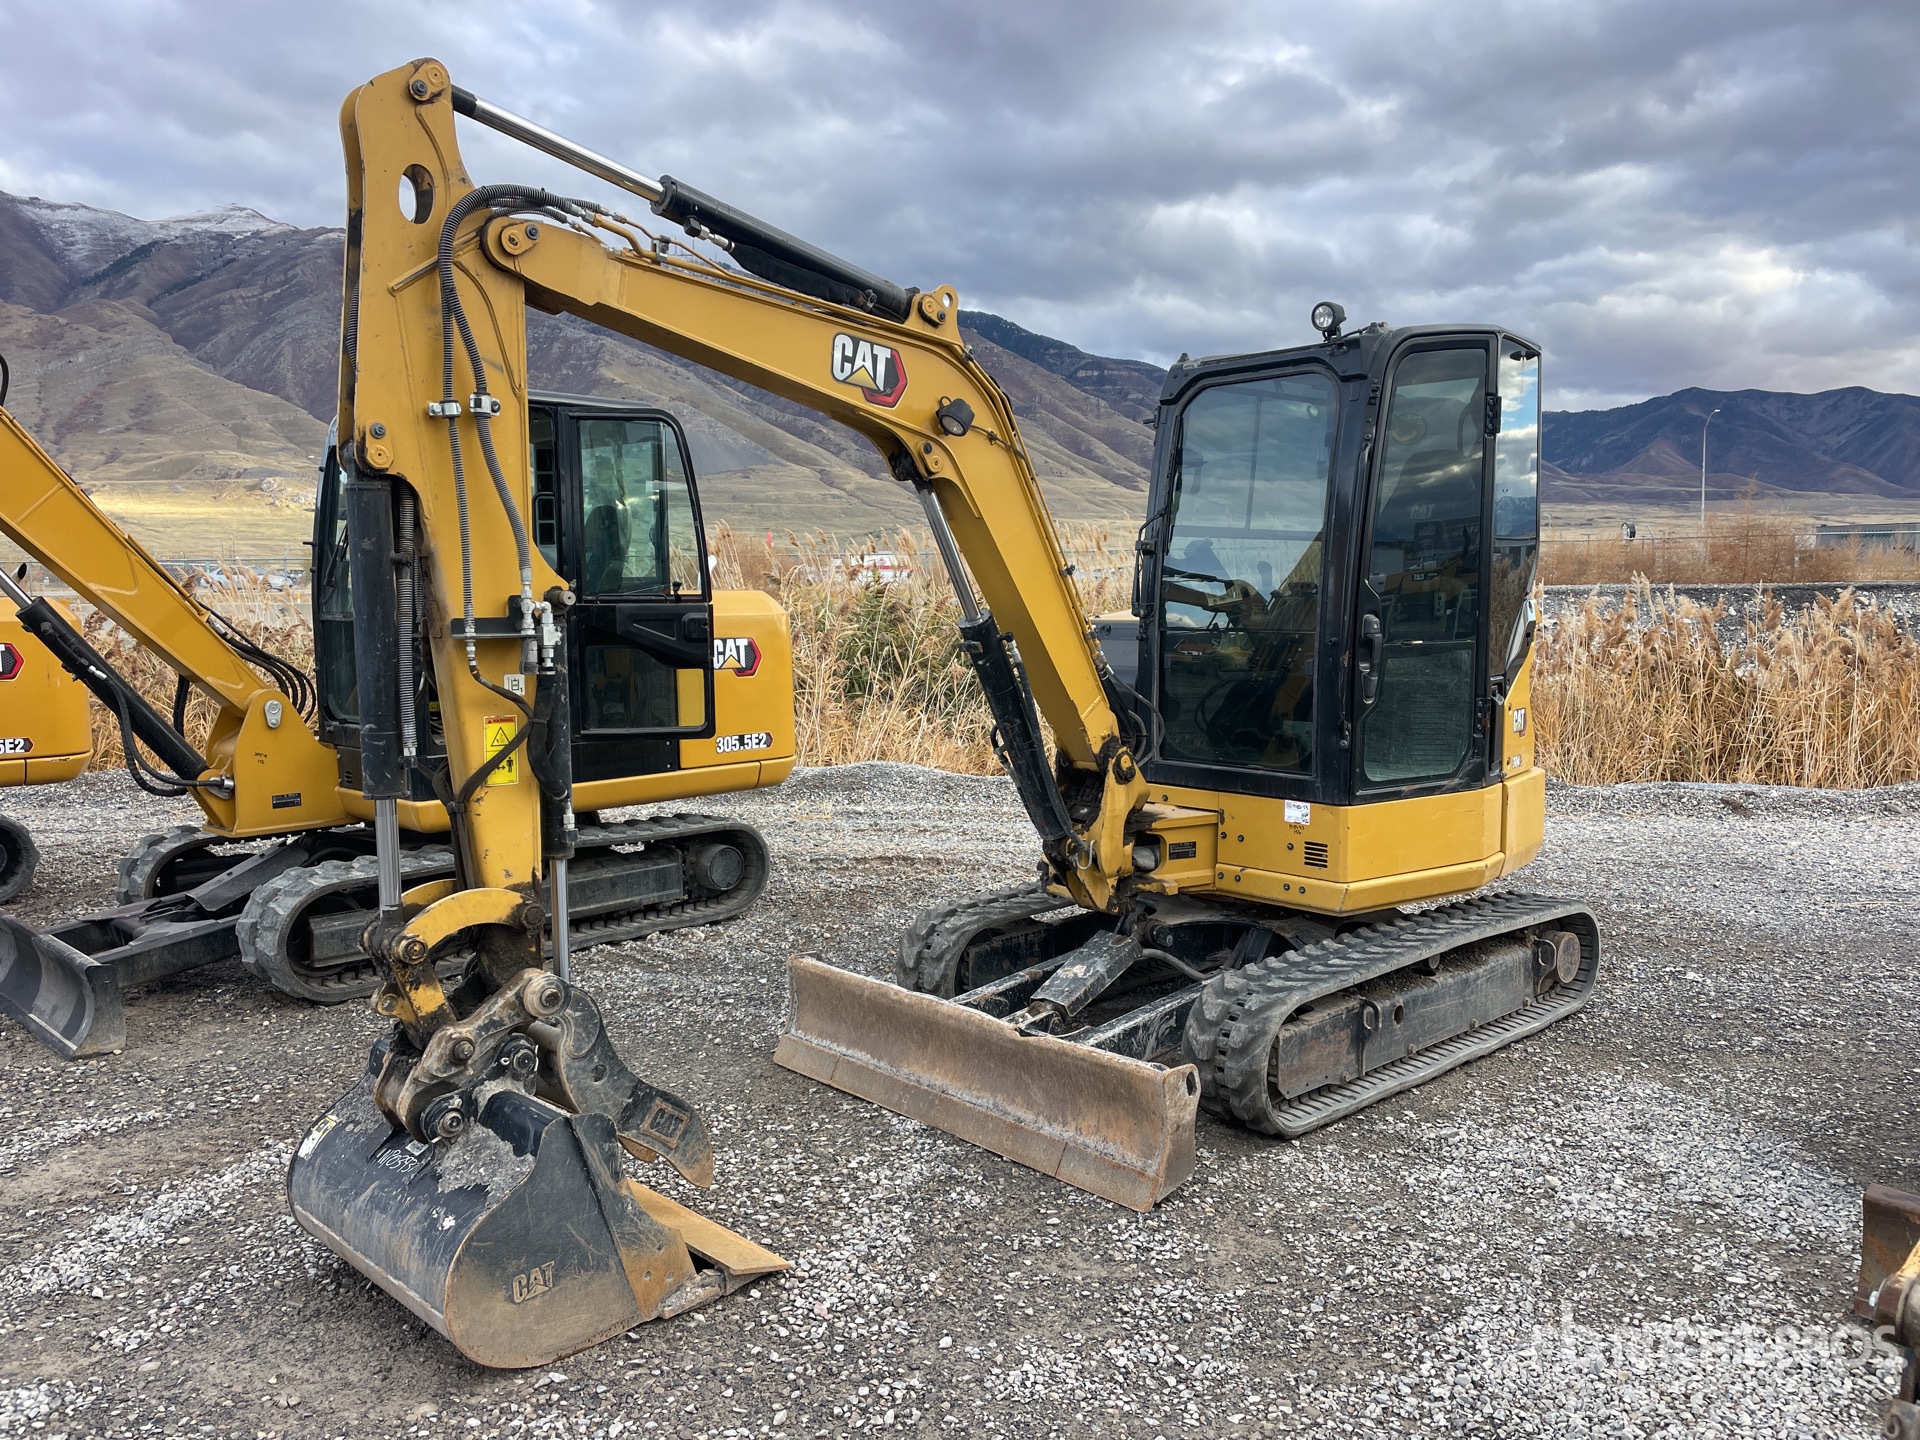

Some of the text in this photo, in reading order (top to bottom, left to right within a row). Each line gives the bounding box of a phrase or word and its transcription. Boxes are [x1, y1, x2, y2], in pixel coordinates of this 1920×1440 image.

[832, 333, 892, 392] CAT
[713, 638, 749, 670] CAT
[1513, 708, 1526, 734] CAT
[715, 732, 768, 754] 305.5E2
[649, 1107, 684, 1139] CAT
[512, 1260, 555, 1304] CAT
